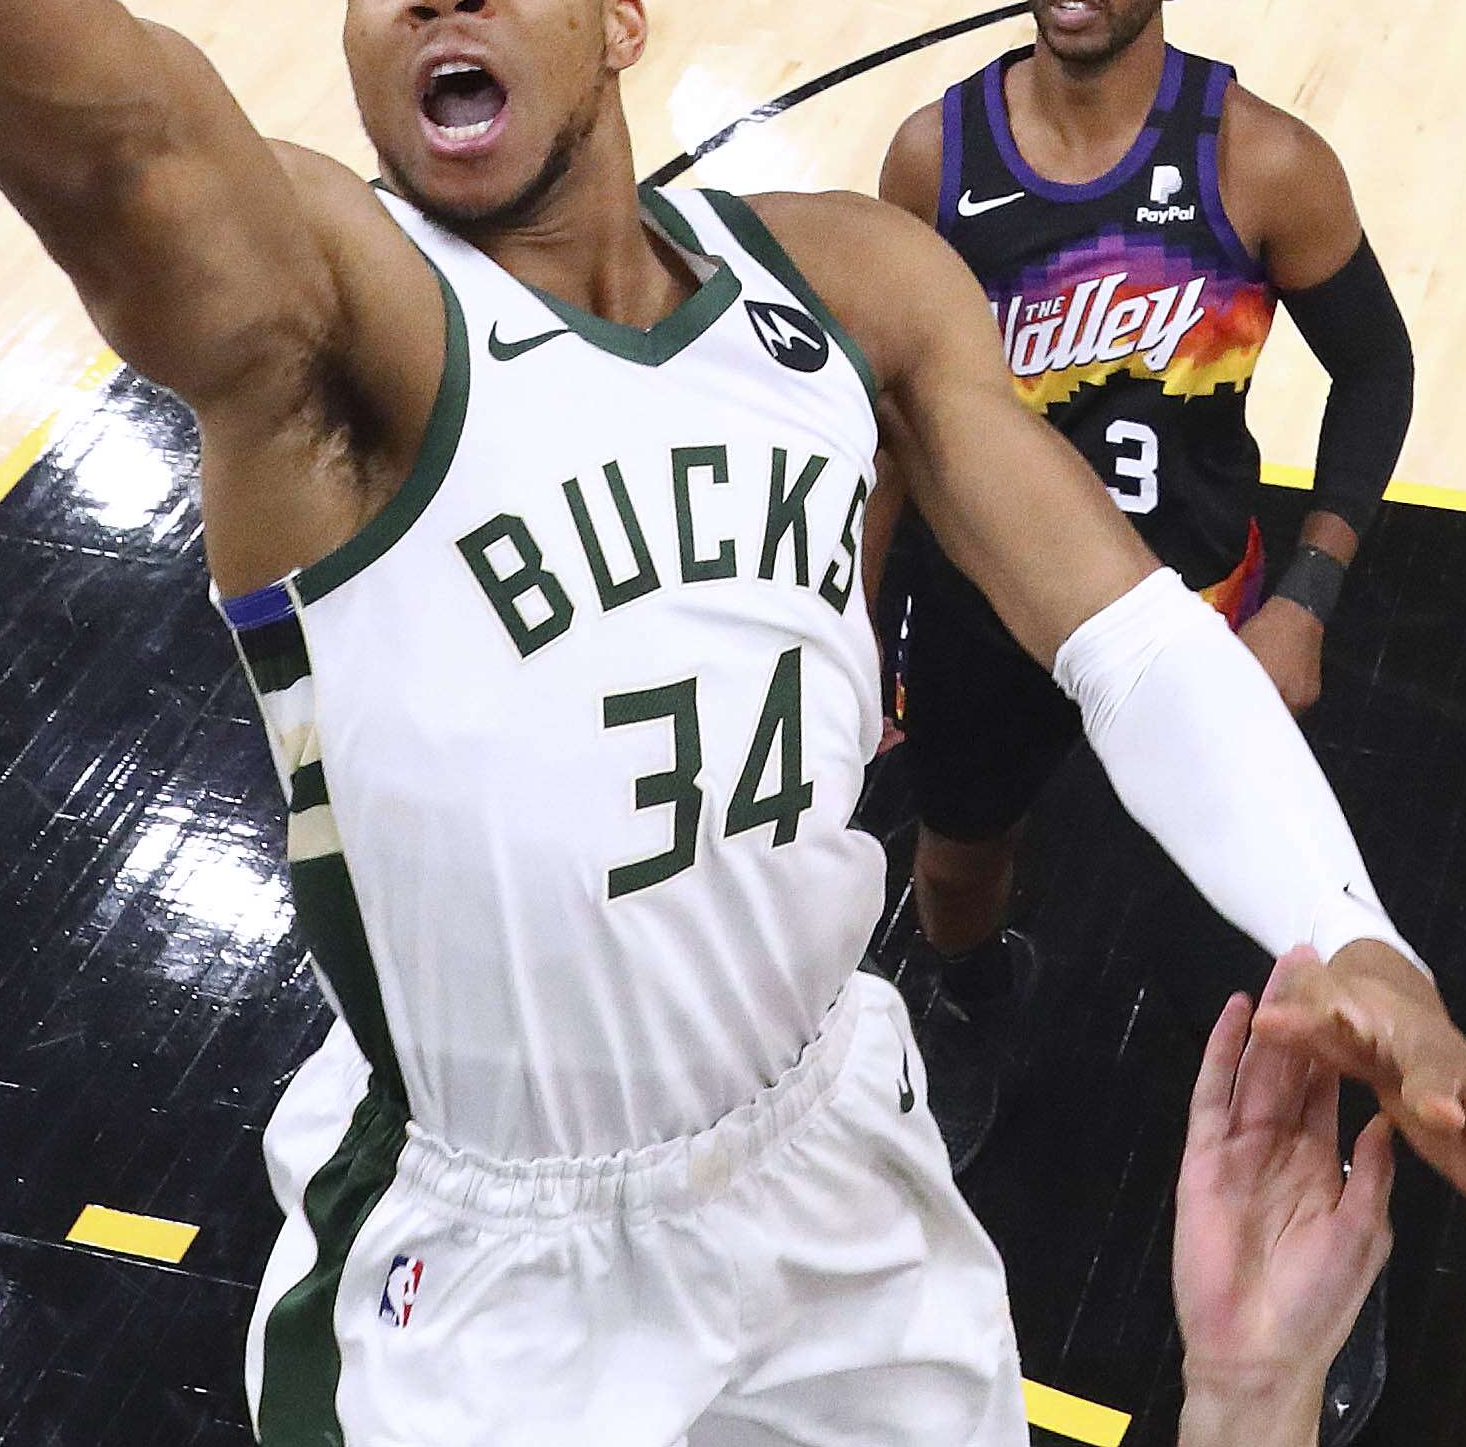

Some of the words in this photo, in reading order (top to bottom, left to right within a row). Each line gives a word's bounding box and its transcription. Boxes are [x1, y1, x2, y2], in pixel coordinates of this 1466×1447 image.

[1136, 204, 1195, 225] PayPal
[1025, 295, 1066, 323] THE
[1105, 419, 1159, 515] 3
[455, 444, 867, 659] BUCKS
[603, 645, 815, 901] 34
